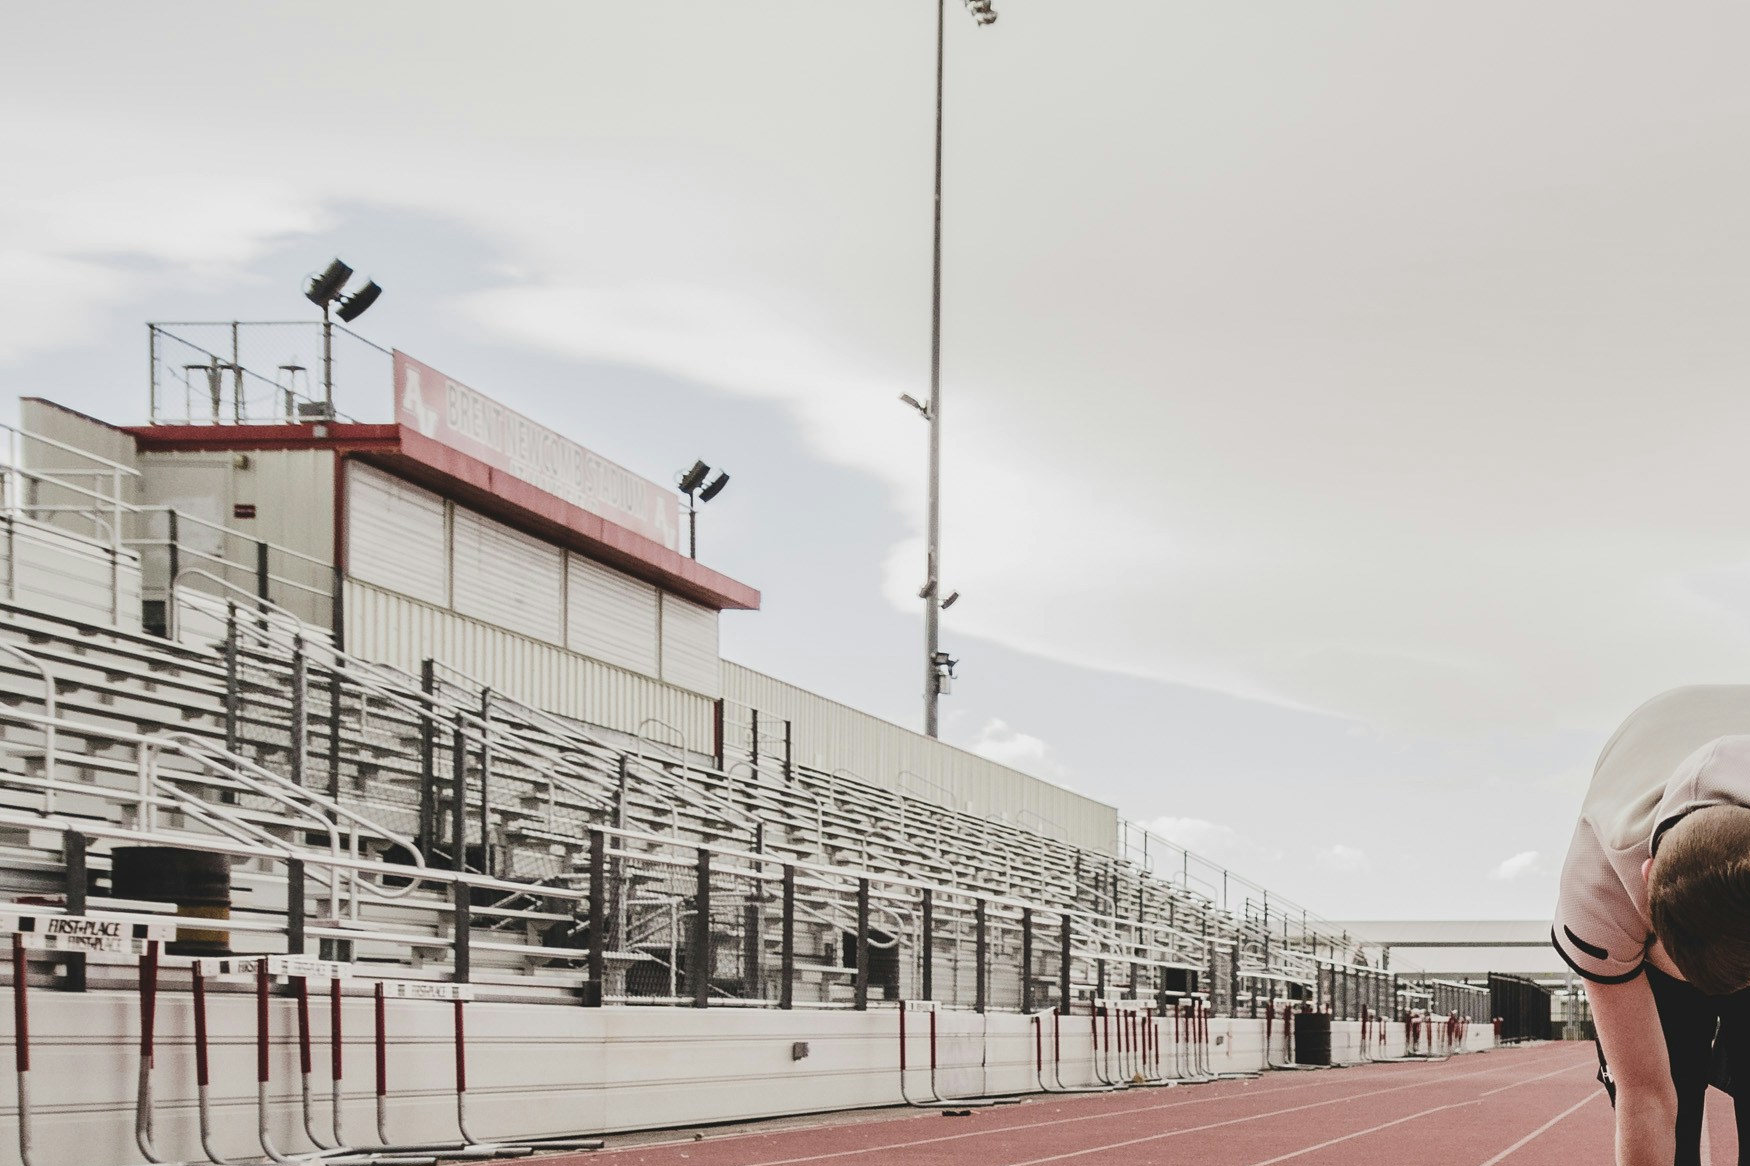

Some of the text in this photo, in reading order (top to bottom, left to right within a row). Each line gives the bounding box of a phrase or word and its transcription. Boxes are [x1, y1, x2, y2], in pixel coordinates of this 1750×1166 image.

[445, 379, 502, 453] BRENT
[503, 408, 584, 490] NEWCOMB
[584, 447, 650, 523] STADIUM
